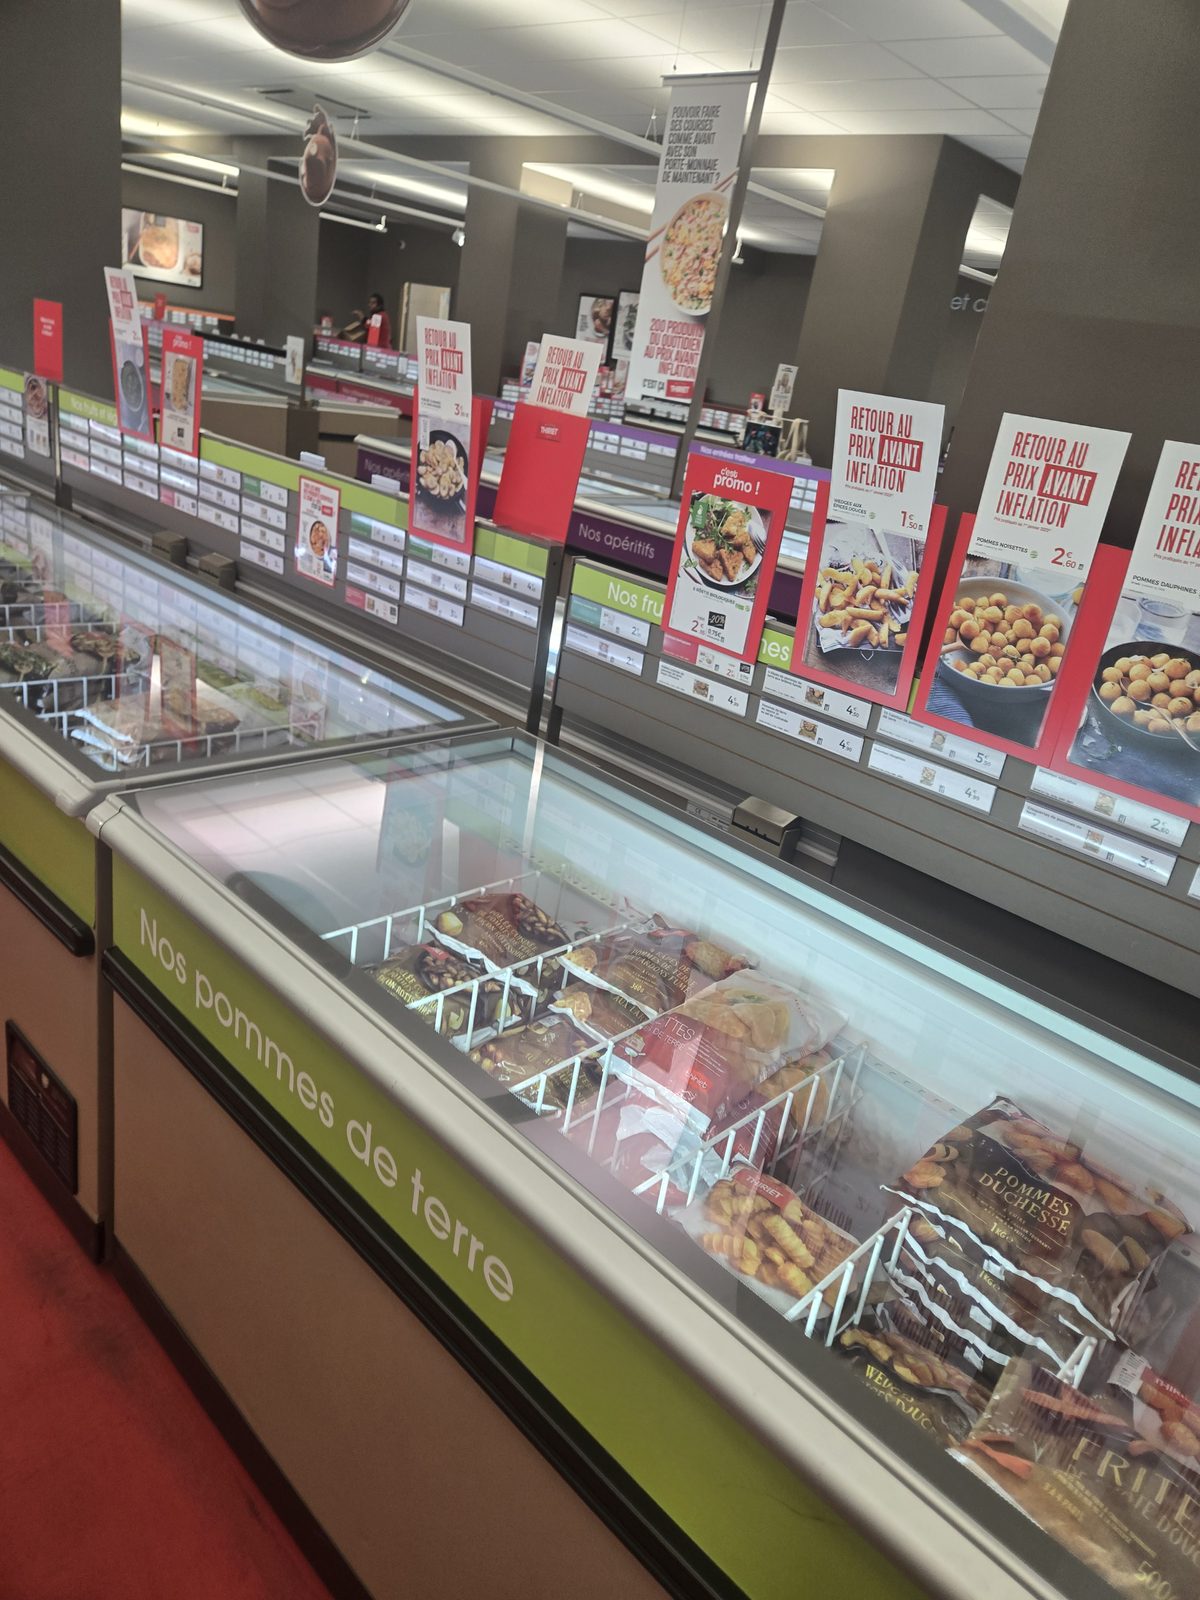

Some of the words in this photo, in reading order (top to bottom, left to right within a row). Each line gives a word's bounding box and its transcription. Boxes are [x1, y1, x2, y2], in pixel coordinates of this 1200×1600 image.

[700, 104, 721, 118] FAIRE
[670, 119, 682, 131] DES
[683, 119, 713, 131] COURSES
[668, 132, 694, 144] COMME
[693, 132, 716, 144] AVANT
[665, 146, 684, 157] AVEC
[684, 146, 698, 157] SON
[662, 170, 672, 183] DE
[672, 171, 714, 184] MAINTENANT
[951, 293, 971, 311] et
[424, 327, 448, 348] RETOUR
[448, 331, 457, 350] AU
[424, 348, 440, 368] PRIX
[442, 352, 461, 372] AVANT
[546, 346, 574, 368] RETOUR
[573, 351, 585, 369] AU
[644, 345, 656, 359] AU
[655, 346, 674, 361] PRIX
[674, 350, 700, 366] AVANT
[426, 368, 457, 391] INFLATION
[542, 366, 560, 386] PRIX
[560, 370, 586, 393] AVANT
[658, 362, 697, 379] INFLATION
[536, 386, 574, 410] INFLATION
[850, 406, 894, 436] RETOUR
[897, 413, 913, 439] AU
[848, 434, 876, 460] PRIX
[880, 438, 920, 468] AVANT
[1010, 432, 1067, 464] RETOUR
[1066, 441, 1090, 469] AU
[364, 458, 381, 476] Nos
[846, 460, 906, 493] INFLATION
[1175, 460, 1200, 492] RE
[713, 473, 753, 494] promo
[1002, 461, 1039, 491] PRIX
[1042, 468, 1092, 502] AVANT
[834, 498, 852, 507] WEDGES
[848, 506, 866, 515] DOUCES
[996, 490, 1070, 528] INFLATION
[578, 522, 601, 544] Nos
[604, 532, 656, 560] apéritifs
[976, 536, 999, 548] POMMES
[1000, 542, 1028, 554] NOISETTES
[608, 582, 638, 609] Nos
[1132, 574, 1160, 586] POMMES
[1160, 581, 1197, 595] DAUPHINES
[138, 907, 187, 984] Nos
[194, 967, 335, 1128] pommes
[346, 1119, 399, 1188] de
[410, 1167, 515, 1303] terre
[746, 1176, 784, 1200] THIRIET
[993, 1166, 1074, 1218] POMMES
[978, 1172, 1072, 1237] DUCHESSE
